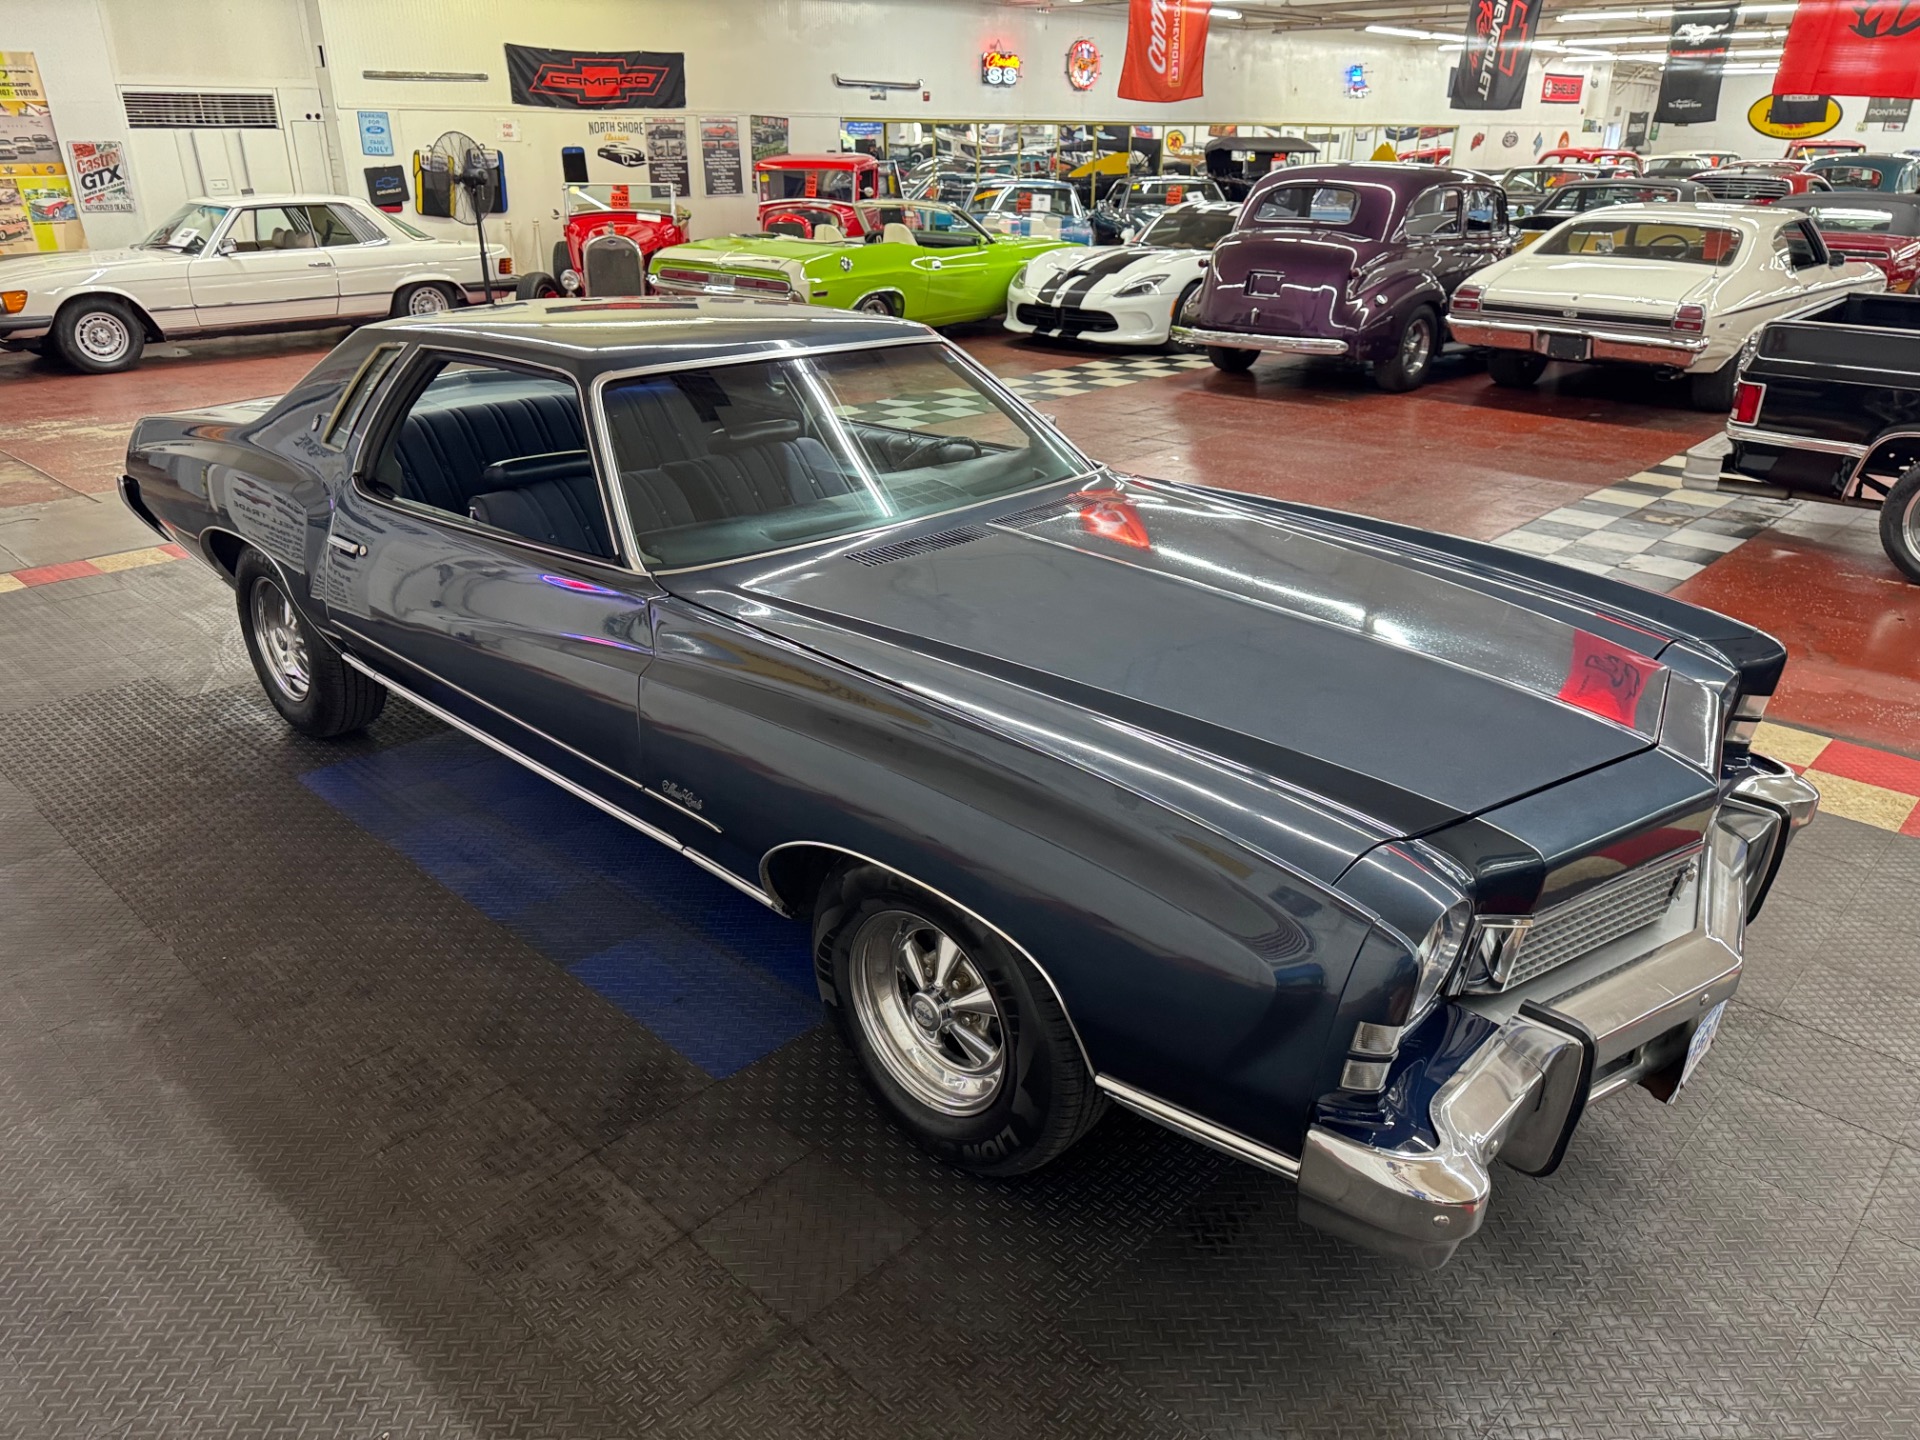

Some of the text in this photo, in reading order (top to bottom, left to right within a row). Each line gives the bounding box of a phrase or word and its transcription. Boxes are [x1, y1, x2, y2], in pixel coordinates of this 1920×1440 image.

[1171, 9, 1181, 81] CHEVROLET
[550, 75, 650, 86] CAMARO
[987, 67, 1017, 84] SS
[1868, 108, 1909, 116] PONTIAC
[588, 121, 644, 135] NORTH SHORE
[604, 133, 630, 141] Classics
[81, 164, 124, 190] GTX
